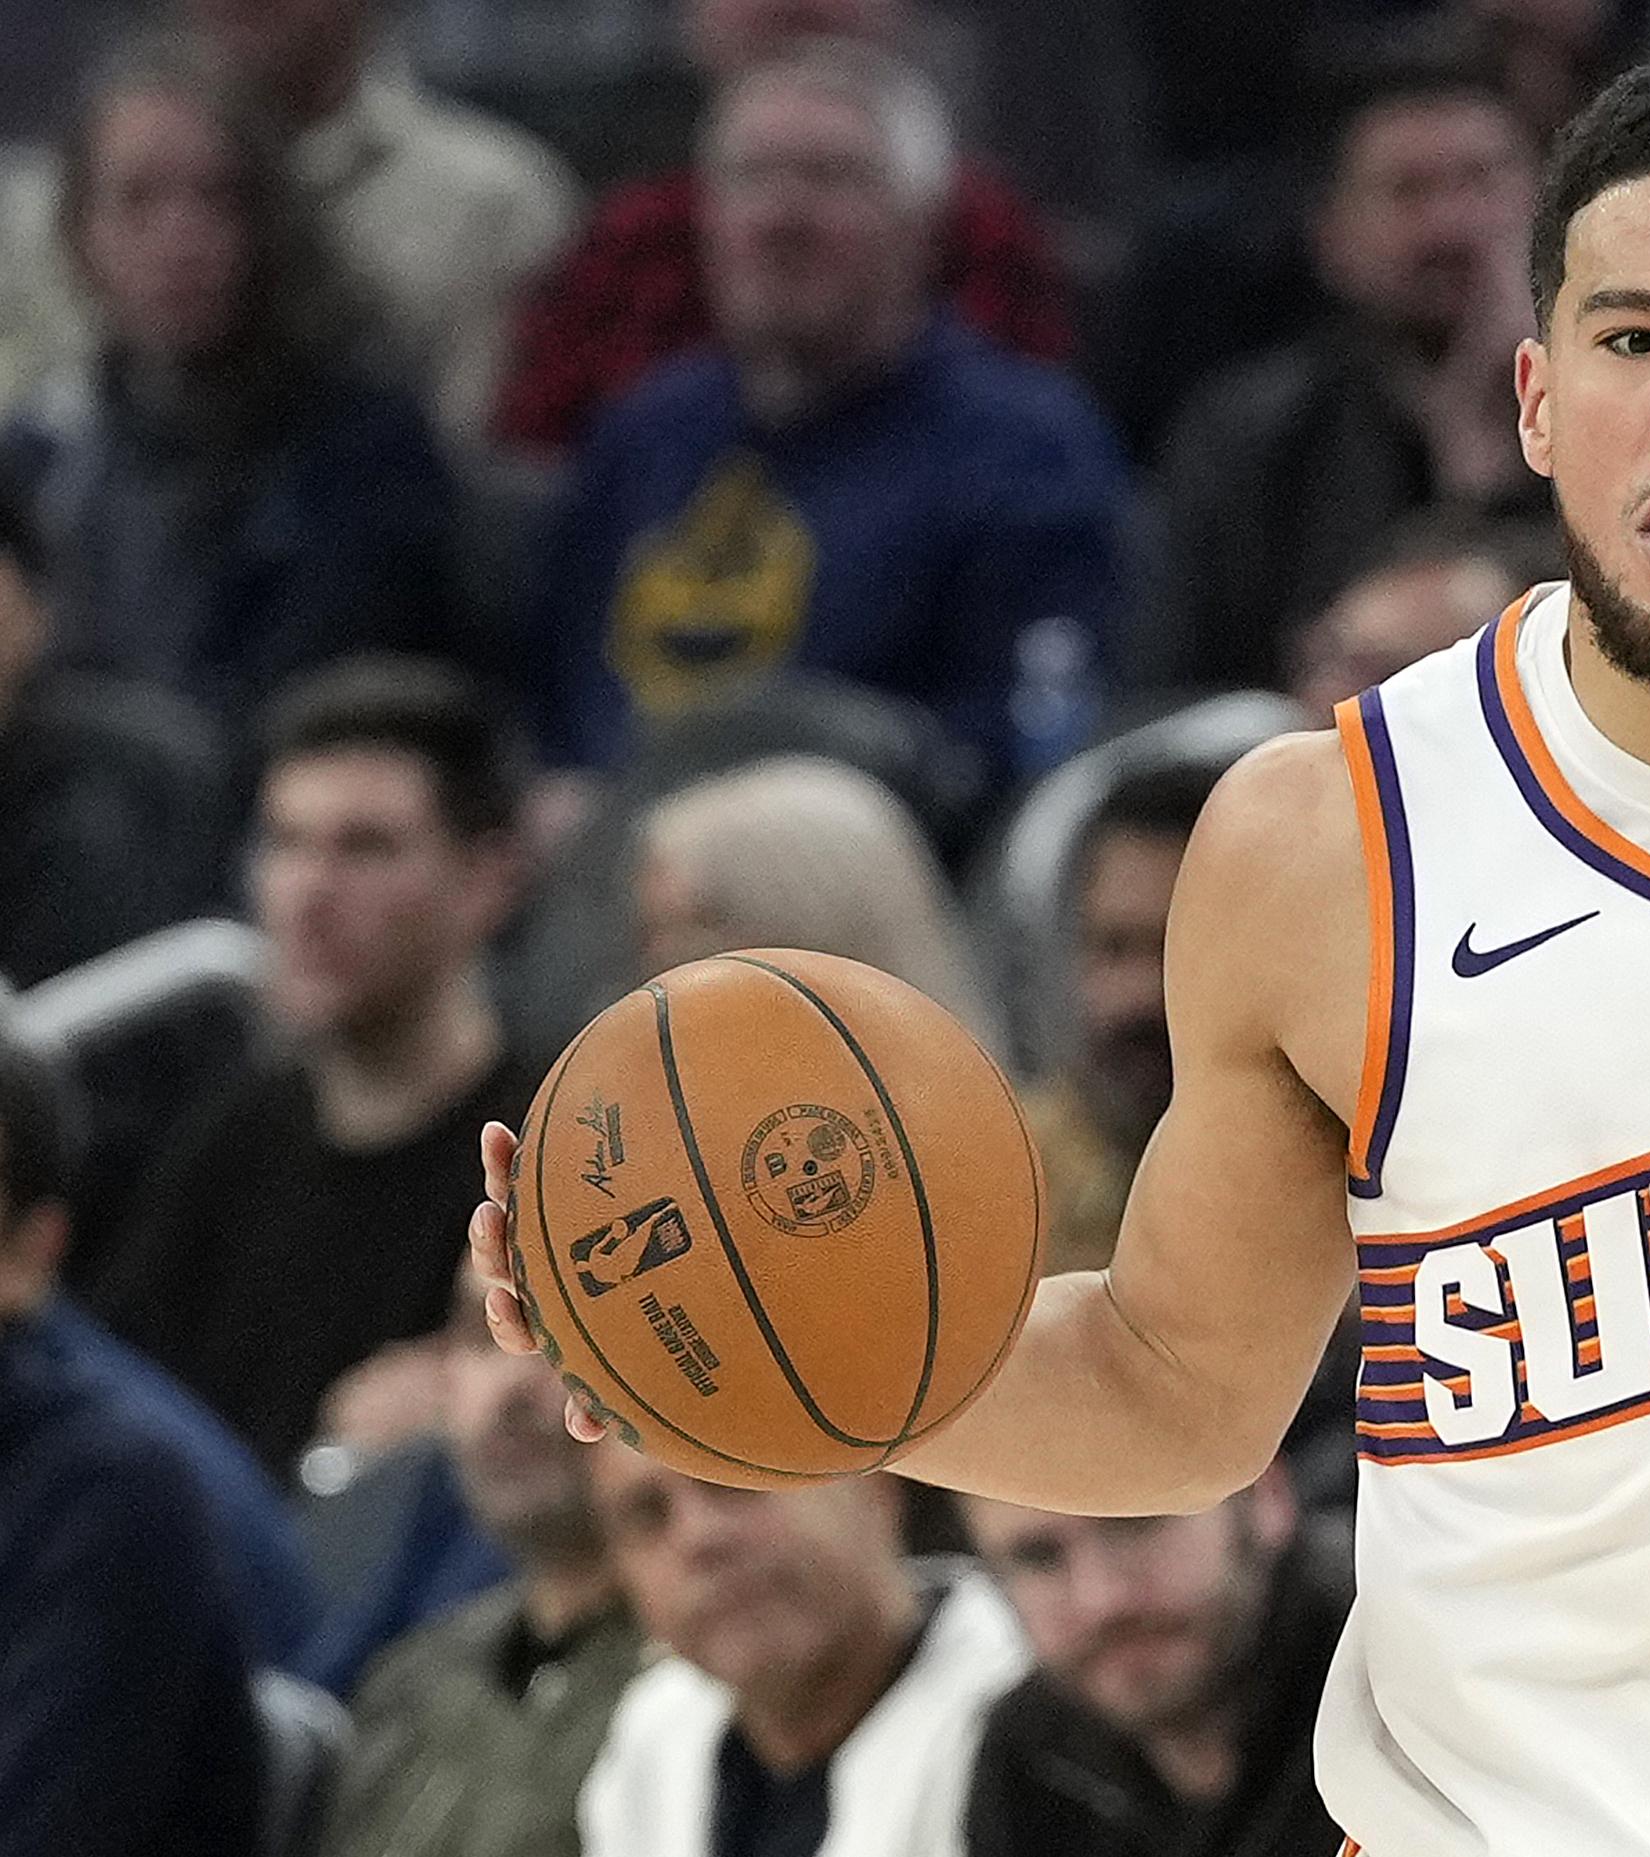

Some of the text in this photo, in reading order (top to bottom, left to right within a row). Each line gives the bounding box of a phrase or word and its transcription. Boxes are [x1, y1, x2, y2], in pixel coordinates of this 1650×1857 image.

[638, 1291, 719, 1397] OFFICIAL GAME BALL
